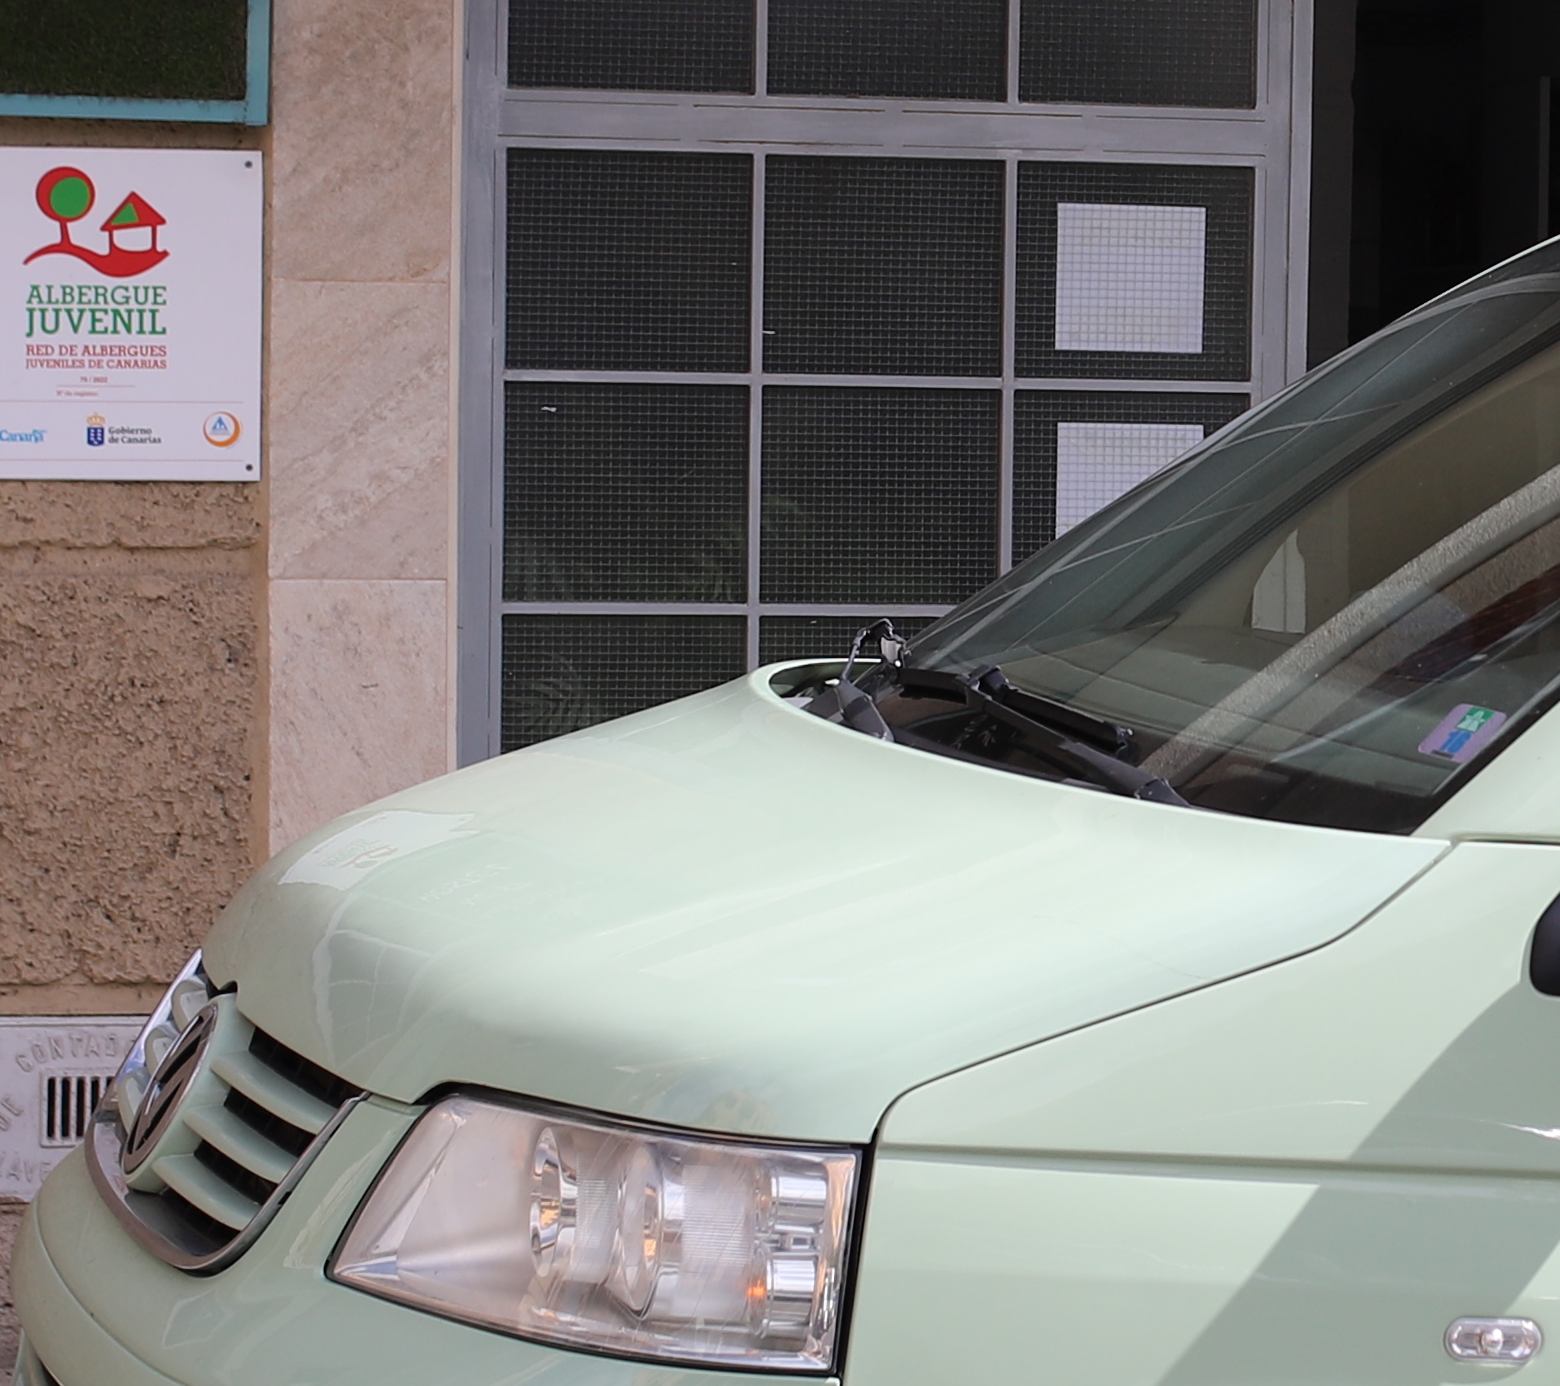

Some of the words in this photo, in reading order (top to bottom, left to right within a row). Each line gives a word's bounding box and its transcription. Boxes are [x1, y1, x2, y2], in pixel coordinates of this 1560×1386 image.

[25, 284, 168, 306] ALBERGUE
[25, 307, 168, 338] JUVENIL
[25, 344, 55, 357] RED
[58, 344, 78, 357] DE
[81, 344, 168, 357] ALBERGUES
[25, 358, 86, 370] JUVENILES
[88, 359, 104, 369] DE
[106, 359, 168, 370] CANARIAS
[108, 426, 152, 435] Gobierno
[108, 435, 120, 444] de
[121, 435, 162, 444] Canarias
